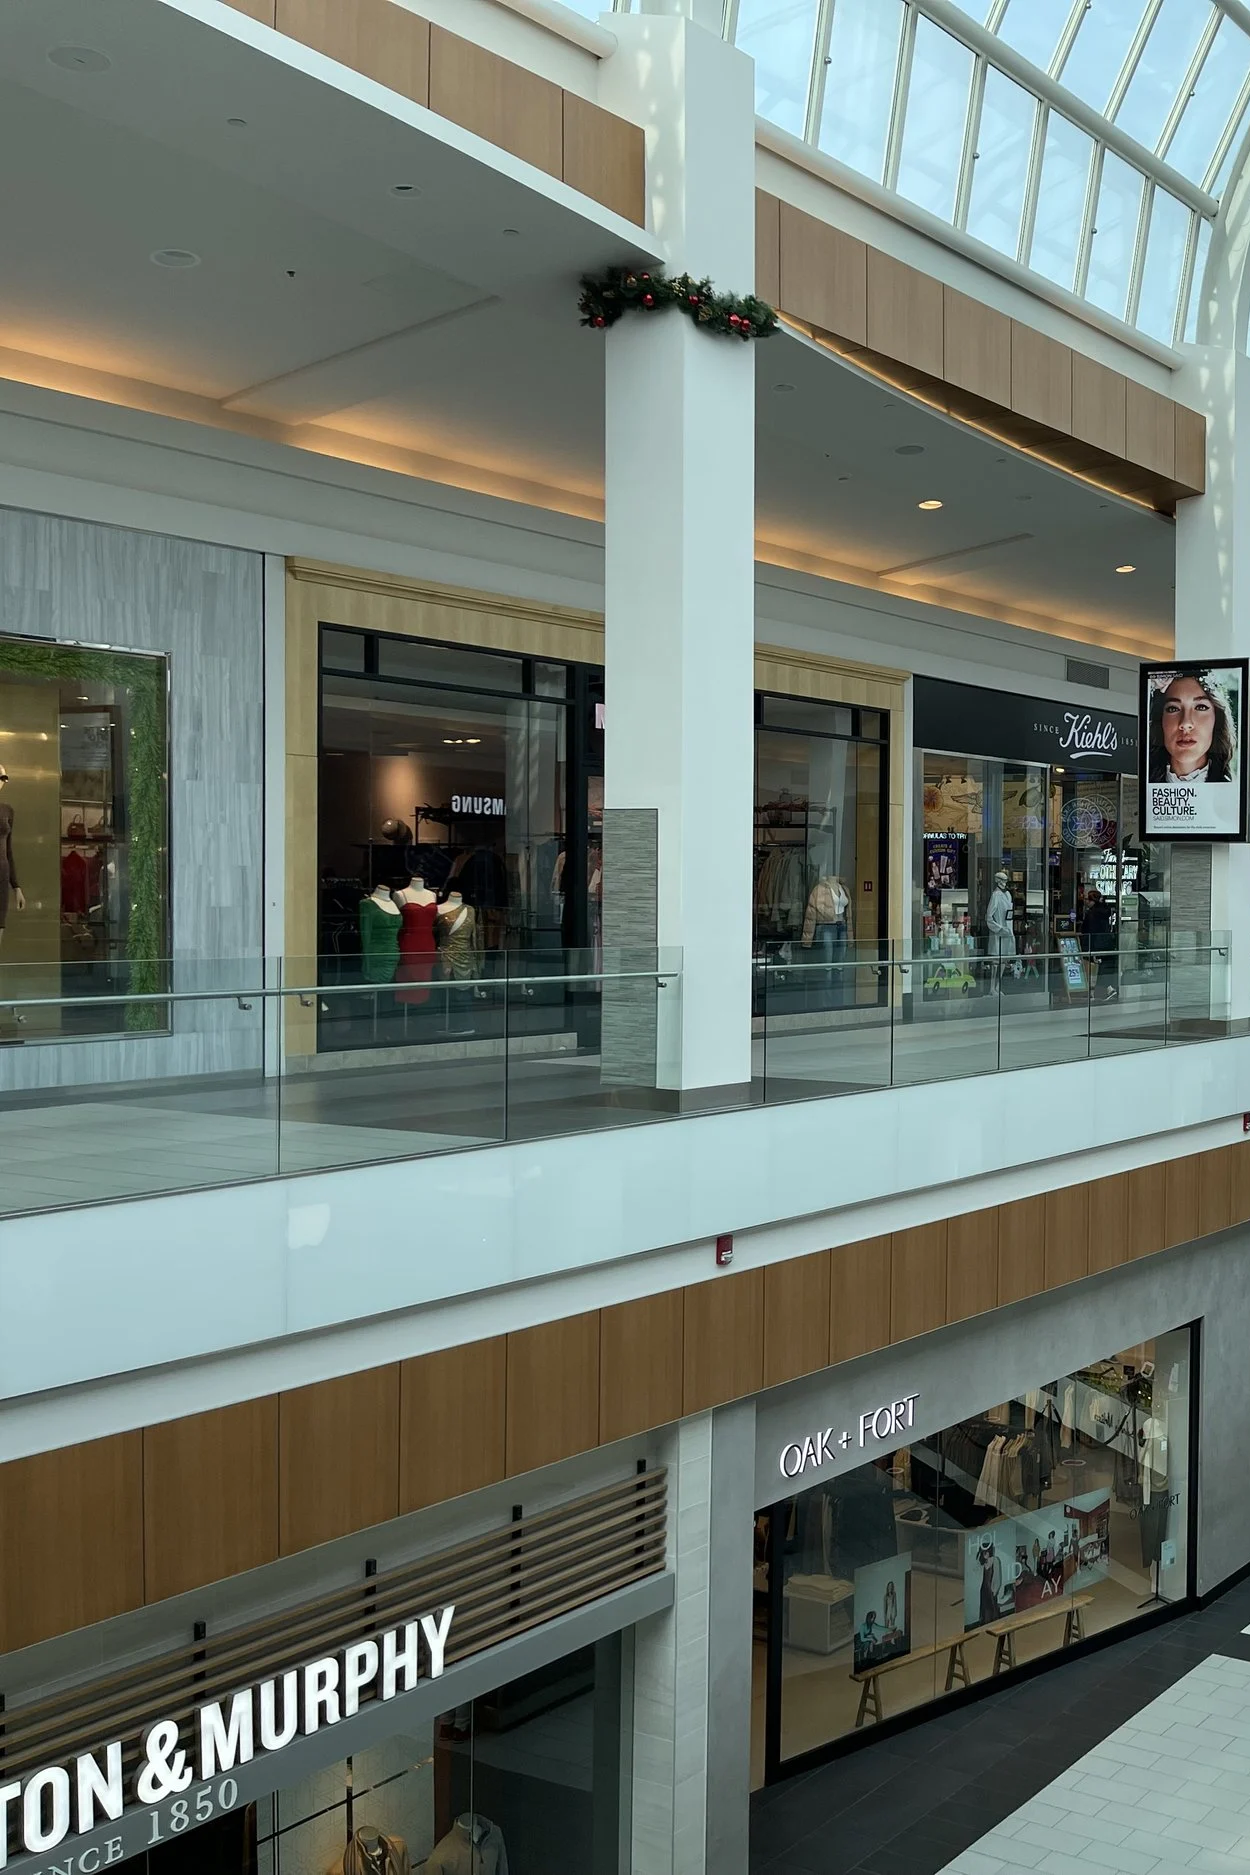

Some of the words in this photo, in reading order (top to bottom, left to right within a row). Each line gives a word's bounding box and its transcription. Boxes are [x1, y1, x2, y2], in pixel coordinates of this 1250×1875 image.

[1033, 723, 1060, 735] SINCE
[1060, 712, 1118, 751] Kiehl's
[1152, 788, 1198, 798] FASHION.
[1152, 798, 1190, 806] BEAUTY.
[1152, 806, 1198, 816] CULTURE.
[780, 1427, 836, 1478] OAK
[838, 1431, 853, 1450] +
[859, 1393, 921, 1448] FORT
[1040, 1575, 1062, 1599] AY
[136, 1719, 194, 1805] &
[200, 1605, 456, 1782] MURPHY
[147, 1778, 238, 1846] 1850
